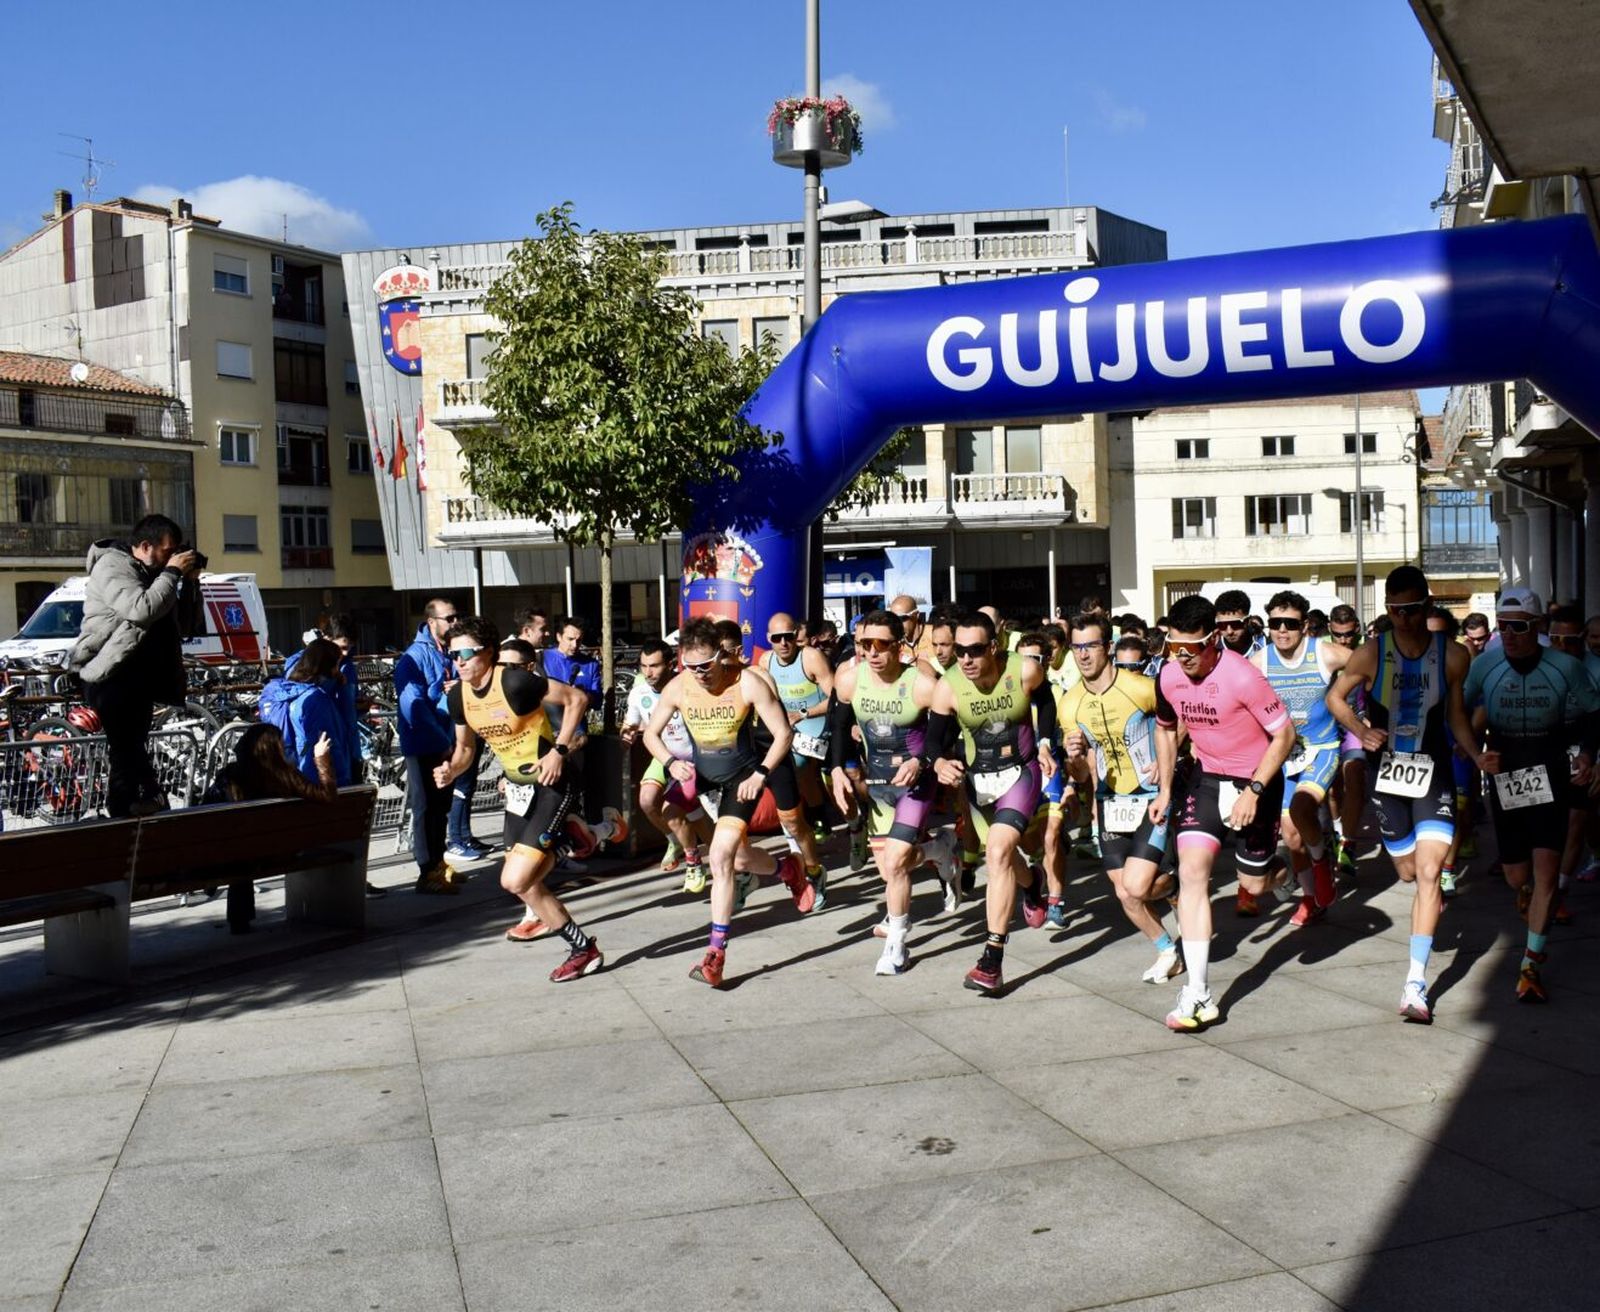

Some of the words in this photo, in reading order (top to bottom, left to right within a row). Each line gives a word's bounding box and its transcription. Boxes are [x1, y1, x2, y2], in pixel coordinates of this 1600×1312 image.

[687, 705, 736, 720] GALLARDO
[861, 698, 904, 714] REGALADO
[970, 694, 1014, 716] REGALADO
[1380, 761, 1429, 786] 2007
[1505, 776, 1544, 796] 1242
[1114, 808, 1136, 822] 106
